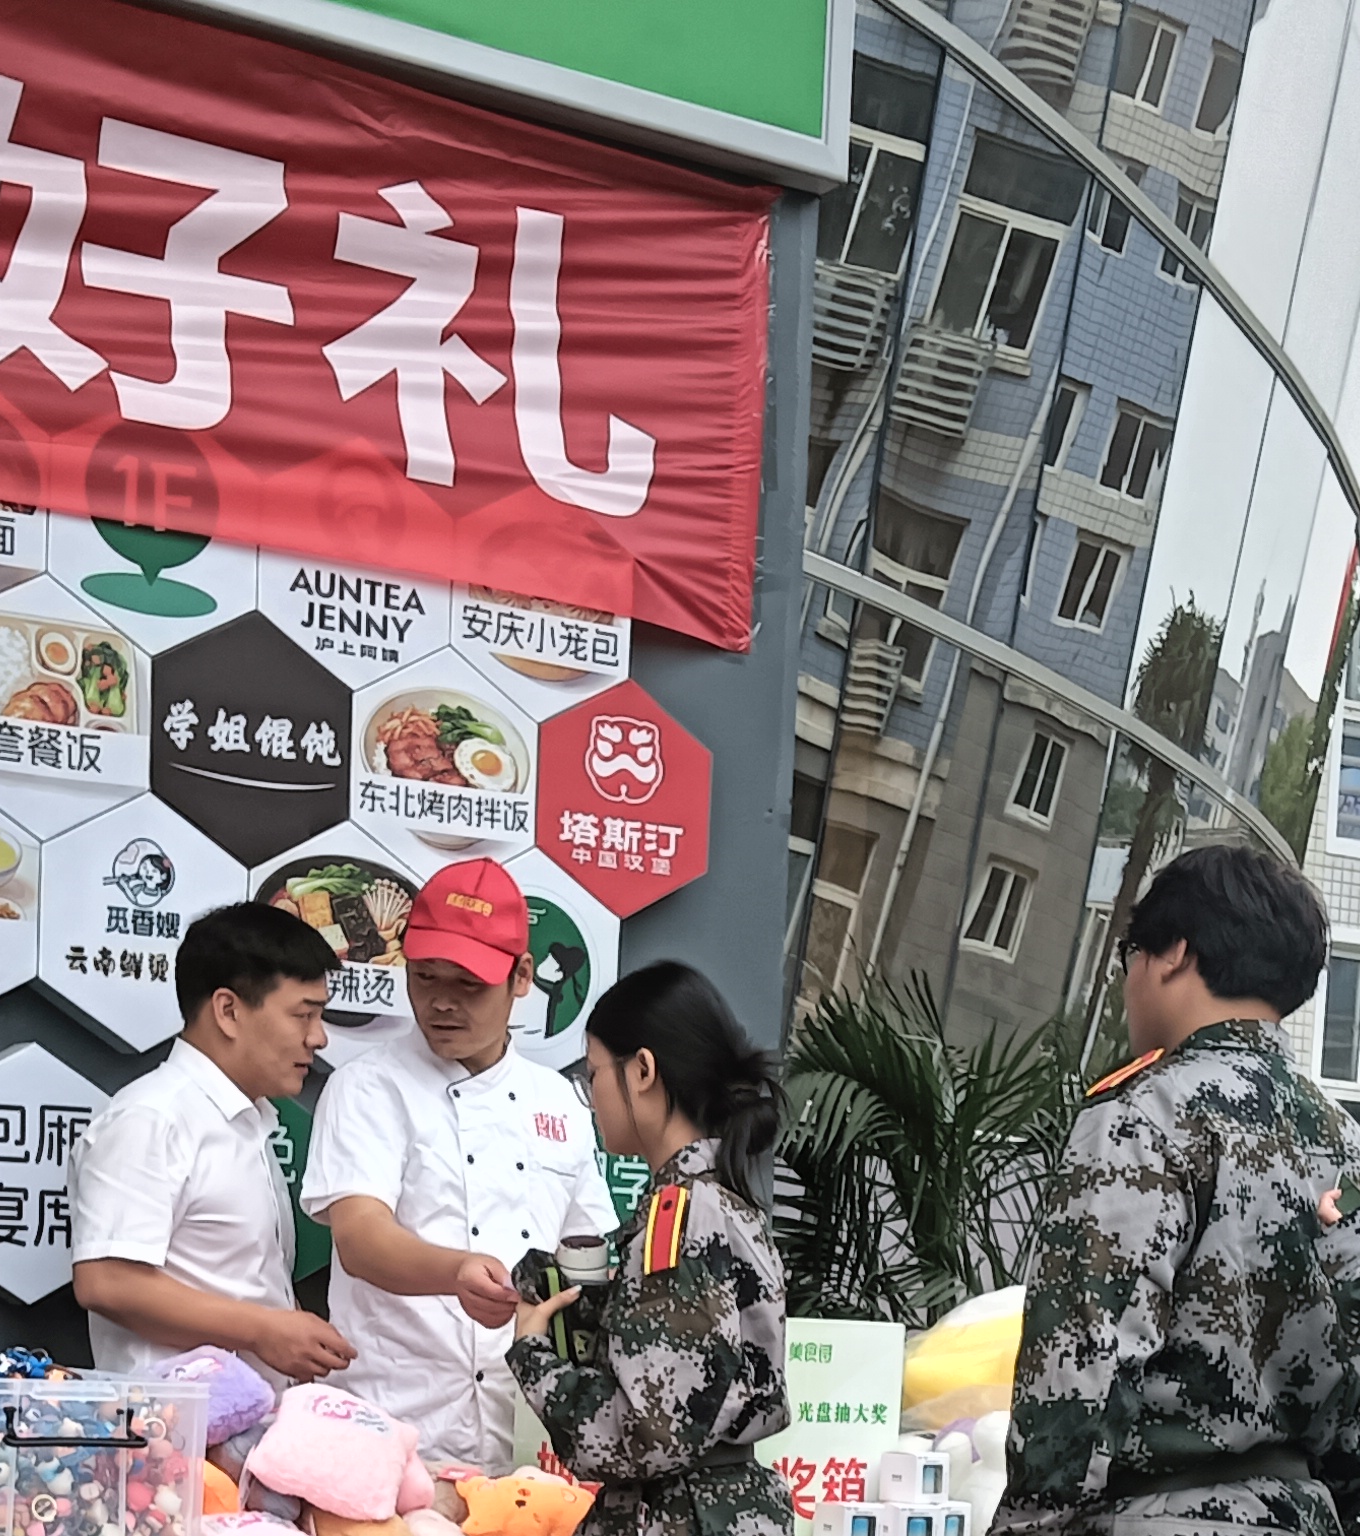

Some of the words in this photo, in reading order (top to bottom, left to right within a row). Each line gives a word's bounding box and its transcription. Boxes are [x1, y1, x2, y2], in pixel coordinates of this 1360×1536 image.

[290, 568, 426, 616] AUNTEA
[301, 602, 414, 644] JENNY
[461, 604, 620, 668] 安庆小笼包
[162, 699, 342, 767] 学姐馄饨
[358, 780, 530, 834] 东北烤肉拌饭
[558, 809, 685, 858] 塔斯汀
[797, 1400, 889, 1425] 光盘抽大奖
